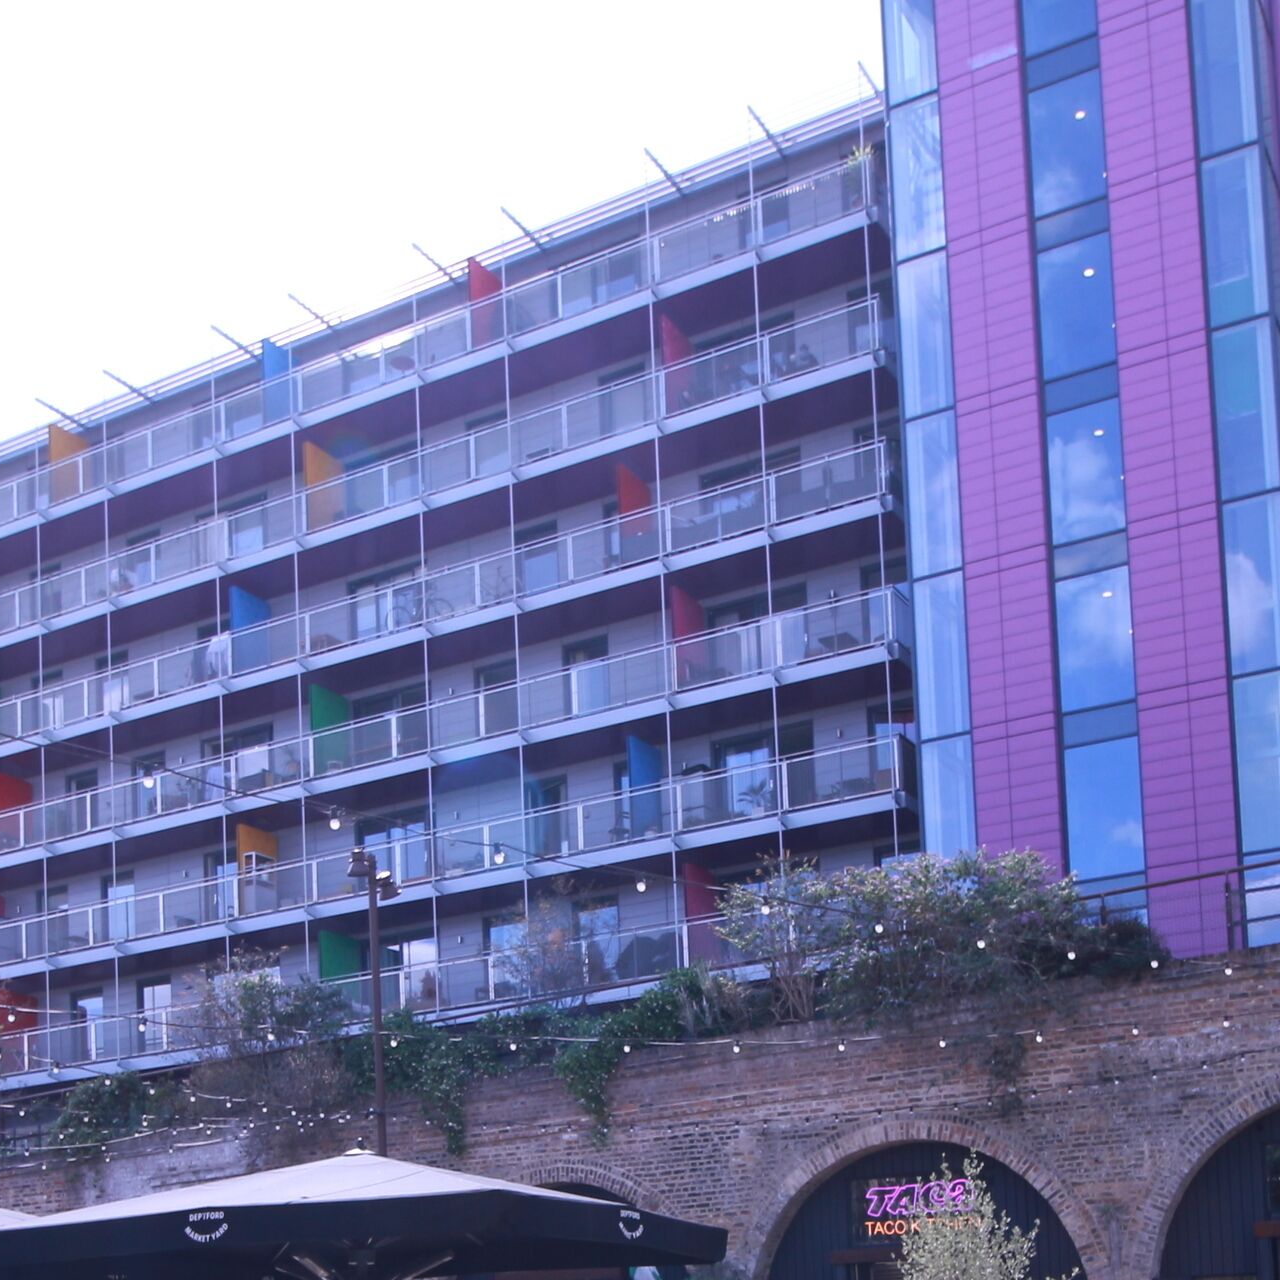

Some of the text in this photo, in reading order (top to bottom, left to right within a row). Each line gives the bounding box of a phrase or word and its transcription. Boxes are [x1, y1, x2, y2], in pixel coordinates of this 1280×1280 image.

[189, 1211, 225, 1222] DEPTFORD
[184, 1222, 228, 1243] MARKET YARD
[865, 1220, 907, 1236] TACO
